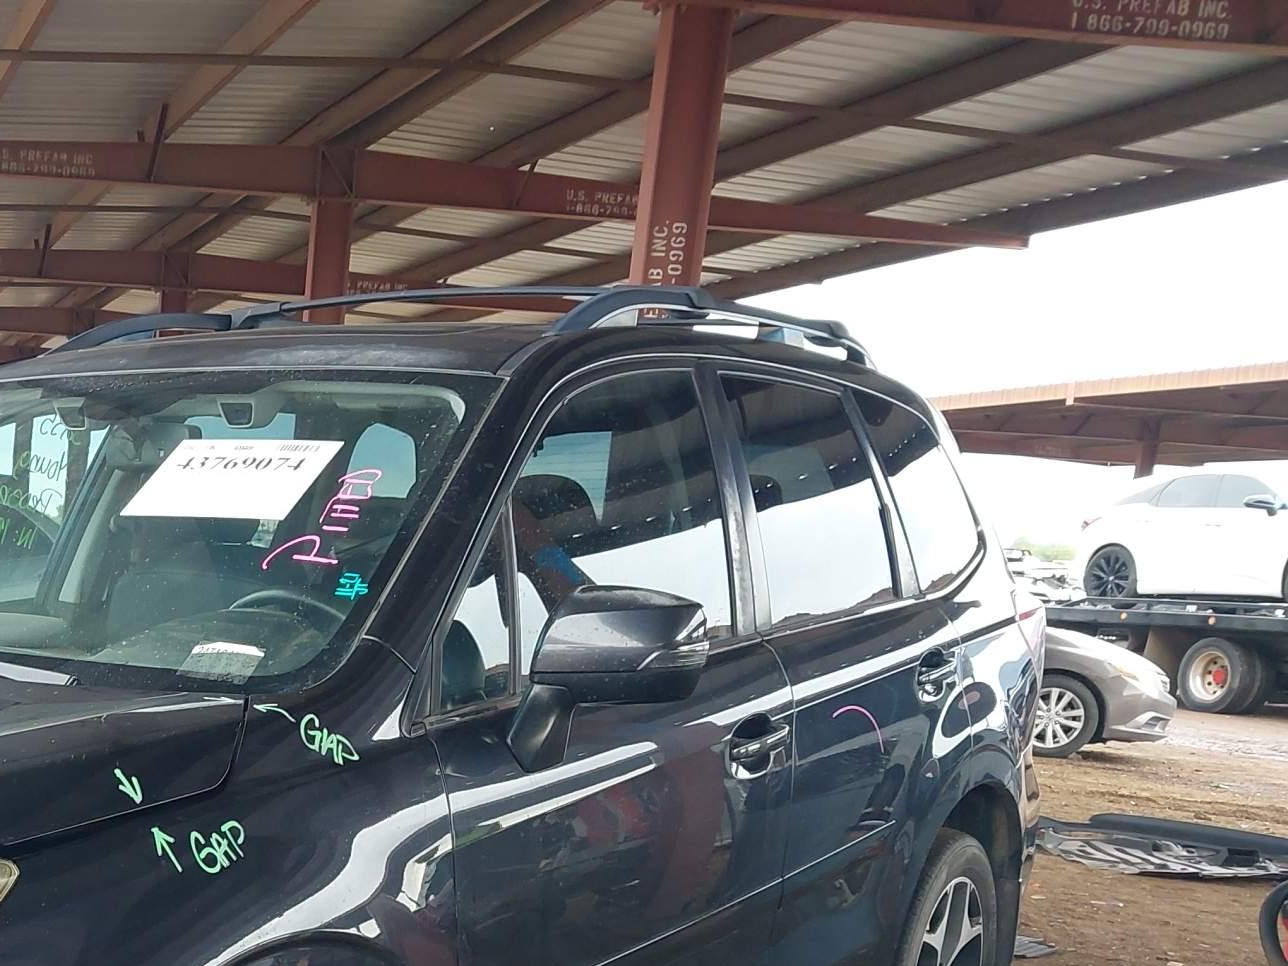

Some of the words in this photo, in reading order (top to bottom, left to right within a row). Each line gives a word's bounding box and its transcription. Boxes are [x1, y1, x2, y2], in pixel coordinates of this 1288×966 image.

[1116, 0, 1191, 16] PREFAB
[650, 220, 669, 257] INC.
[176, 456, 306, 471] 43769074
[299, 713, 361, 766] GAP
[189, 819, 246, 875] GAP
